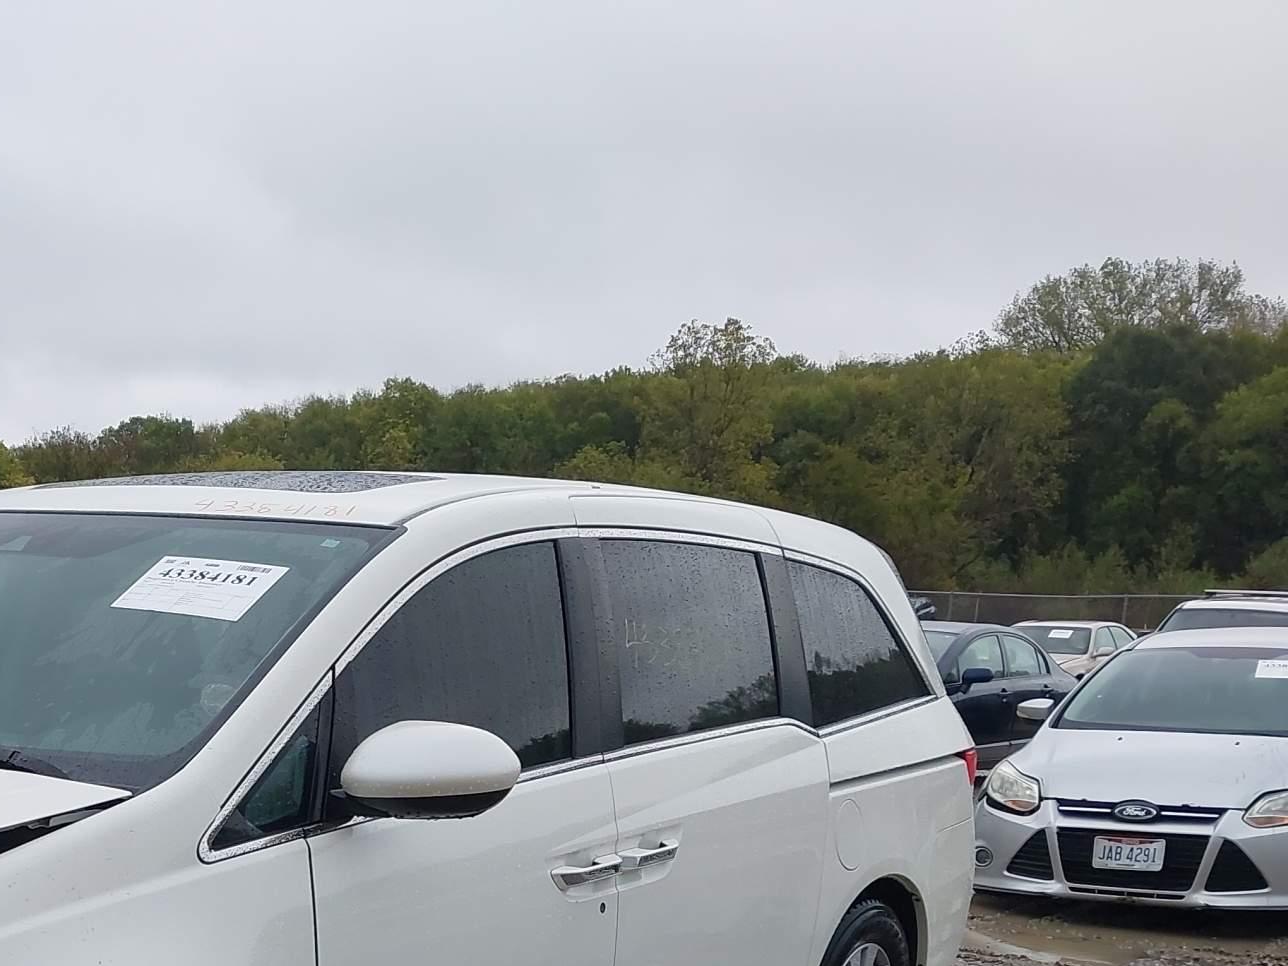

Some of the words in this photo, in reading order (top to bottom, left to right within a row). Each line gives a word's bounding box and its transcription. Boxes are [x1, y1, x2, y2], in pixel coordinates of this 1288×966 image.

[159, 567, 259, 586] 43384181
[1122, 806, 1148, 817] Ford
[1097, 844, 1123, 862] JAB
[1125, 846, 1158, 863] 4291
